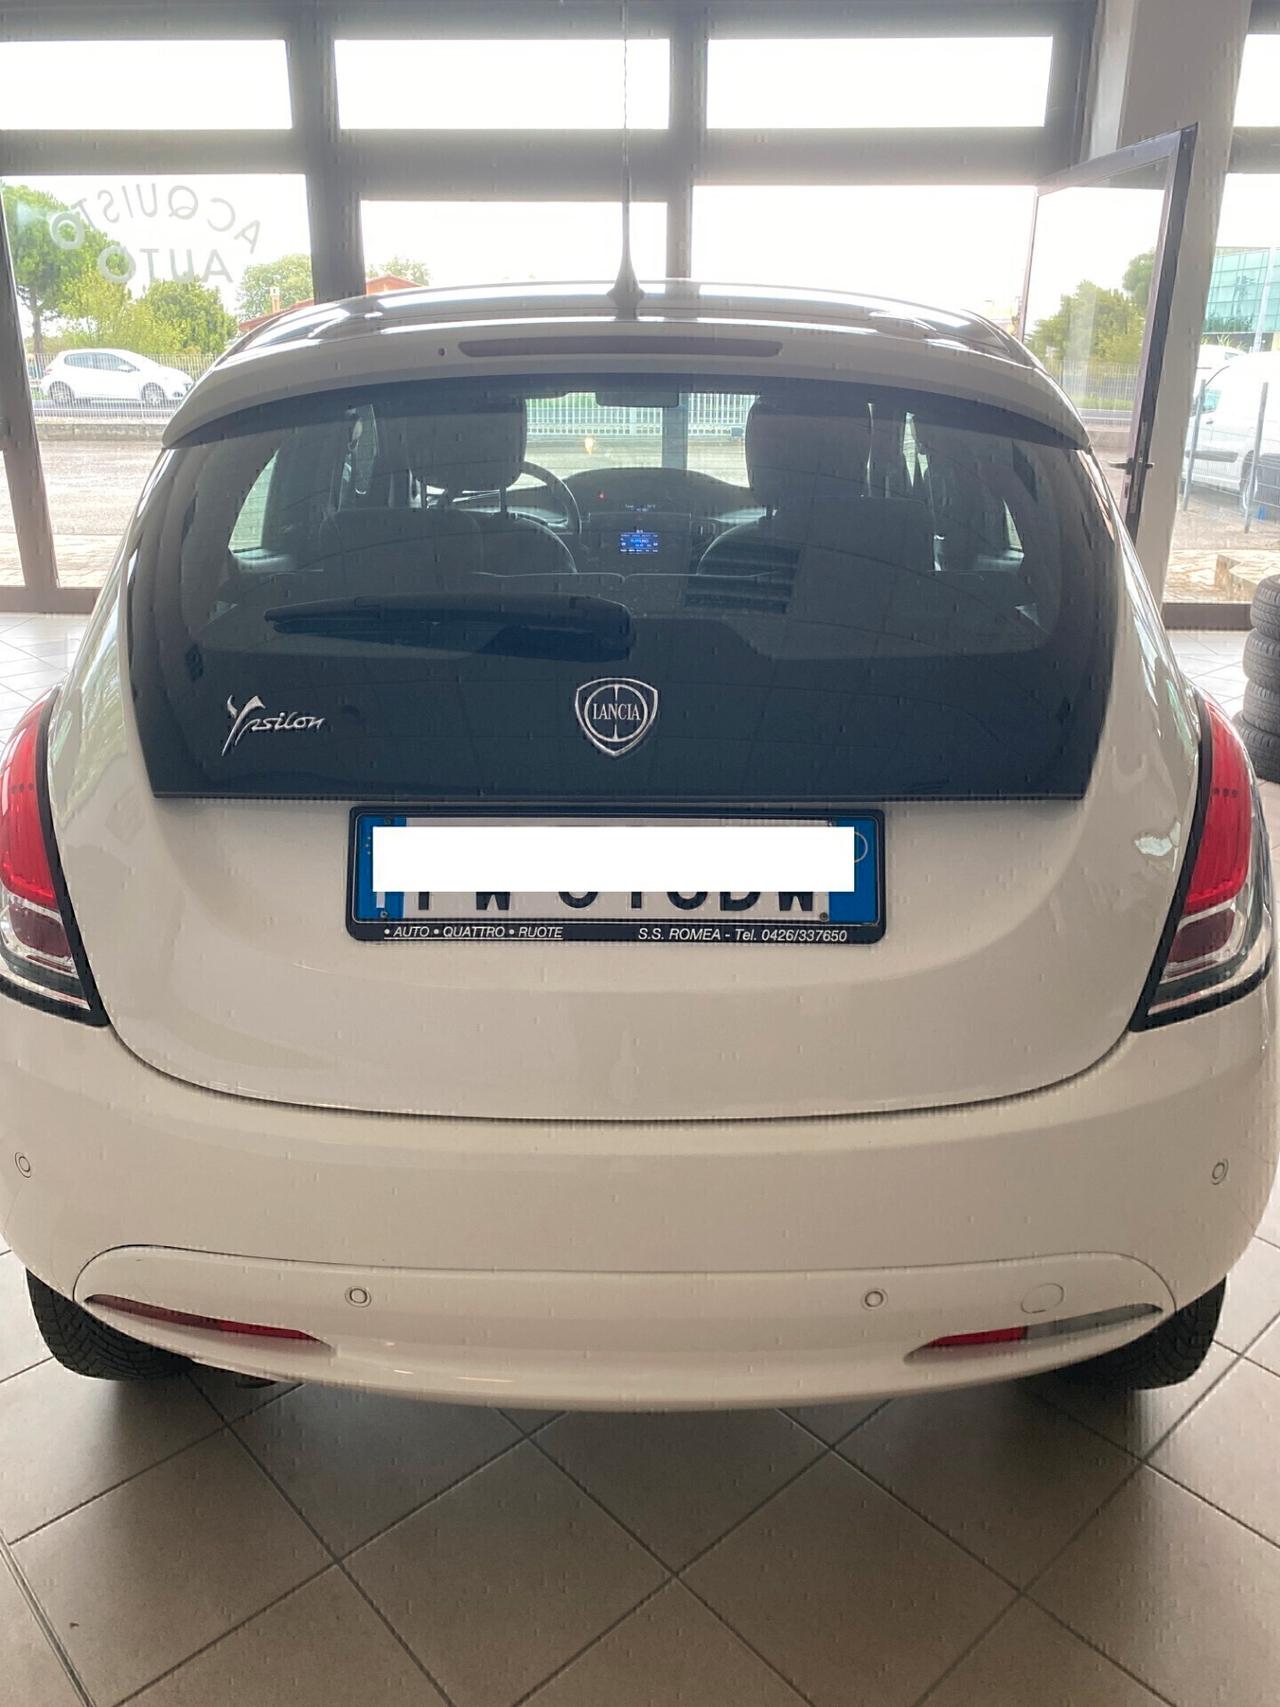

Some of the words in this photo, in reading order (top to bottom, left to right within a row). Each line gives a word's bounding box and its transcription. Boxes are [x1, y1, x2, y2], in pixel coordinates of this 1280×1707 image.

[592, 703, 641, 721] LANCIA
[221, 694, 325, 757] Ypsilon
[393, 926, 430, 938] AUTO
[442, 926, 505, 938] QUATTRO
[518, 926, 563, 938] RUOTE
[638, 927, 664, 941] S.S.
[668, 928, 721, 941] ROMEA
[735, 928, 757, 941] Tel.
[761, 928, 848, 942] 0426/337650
